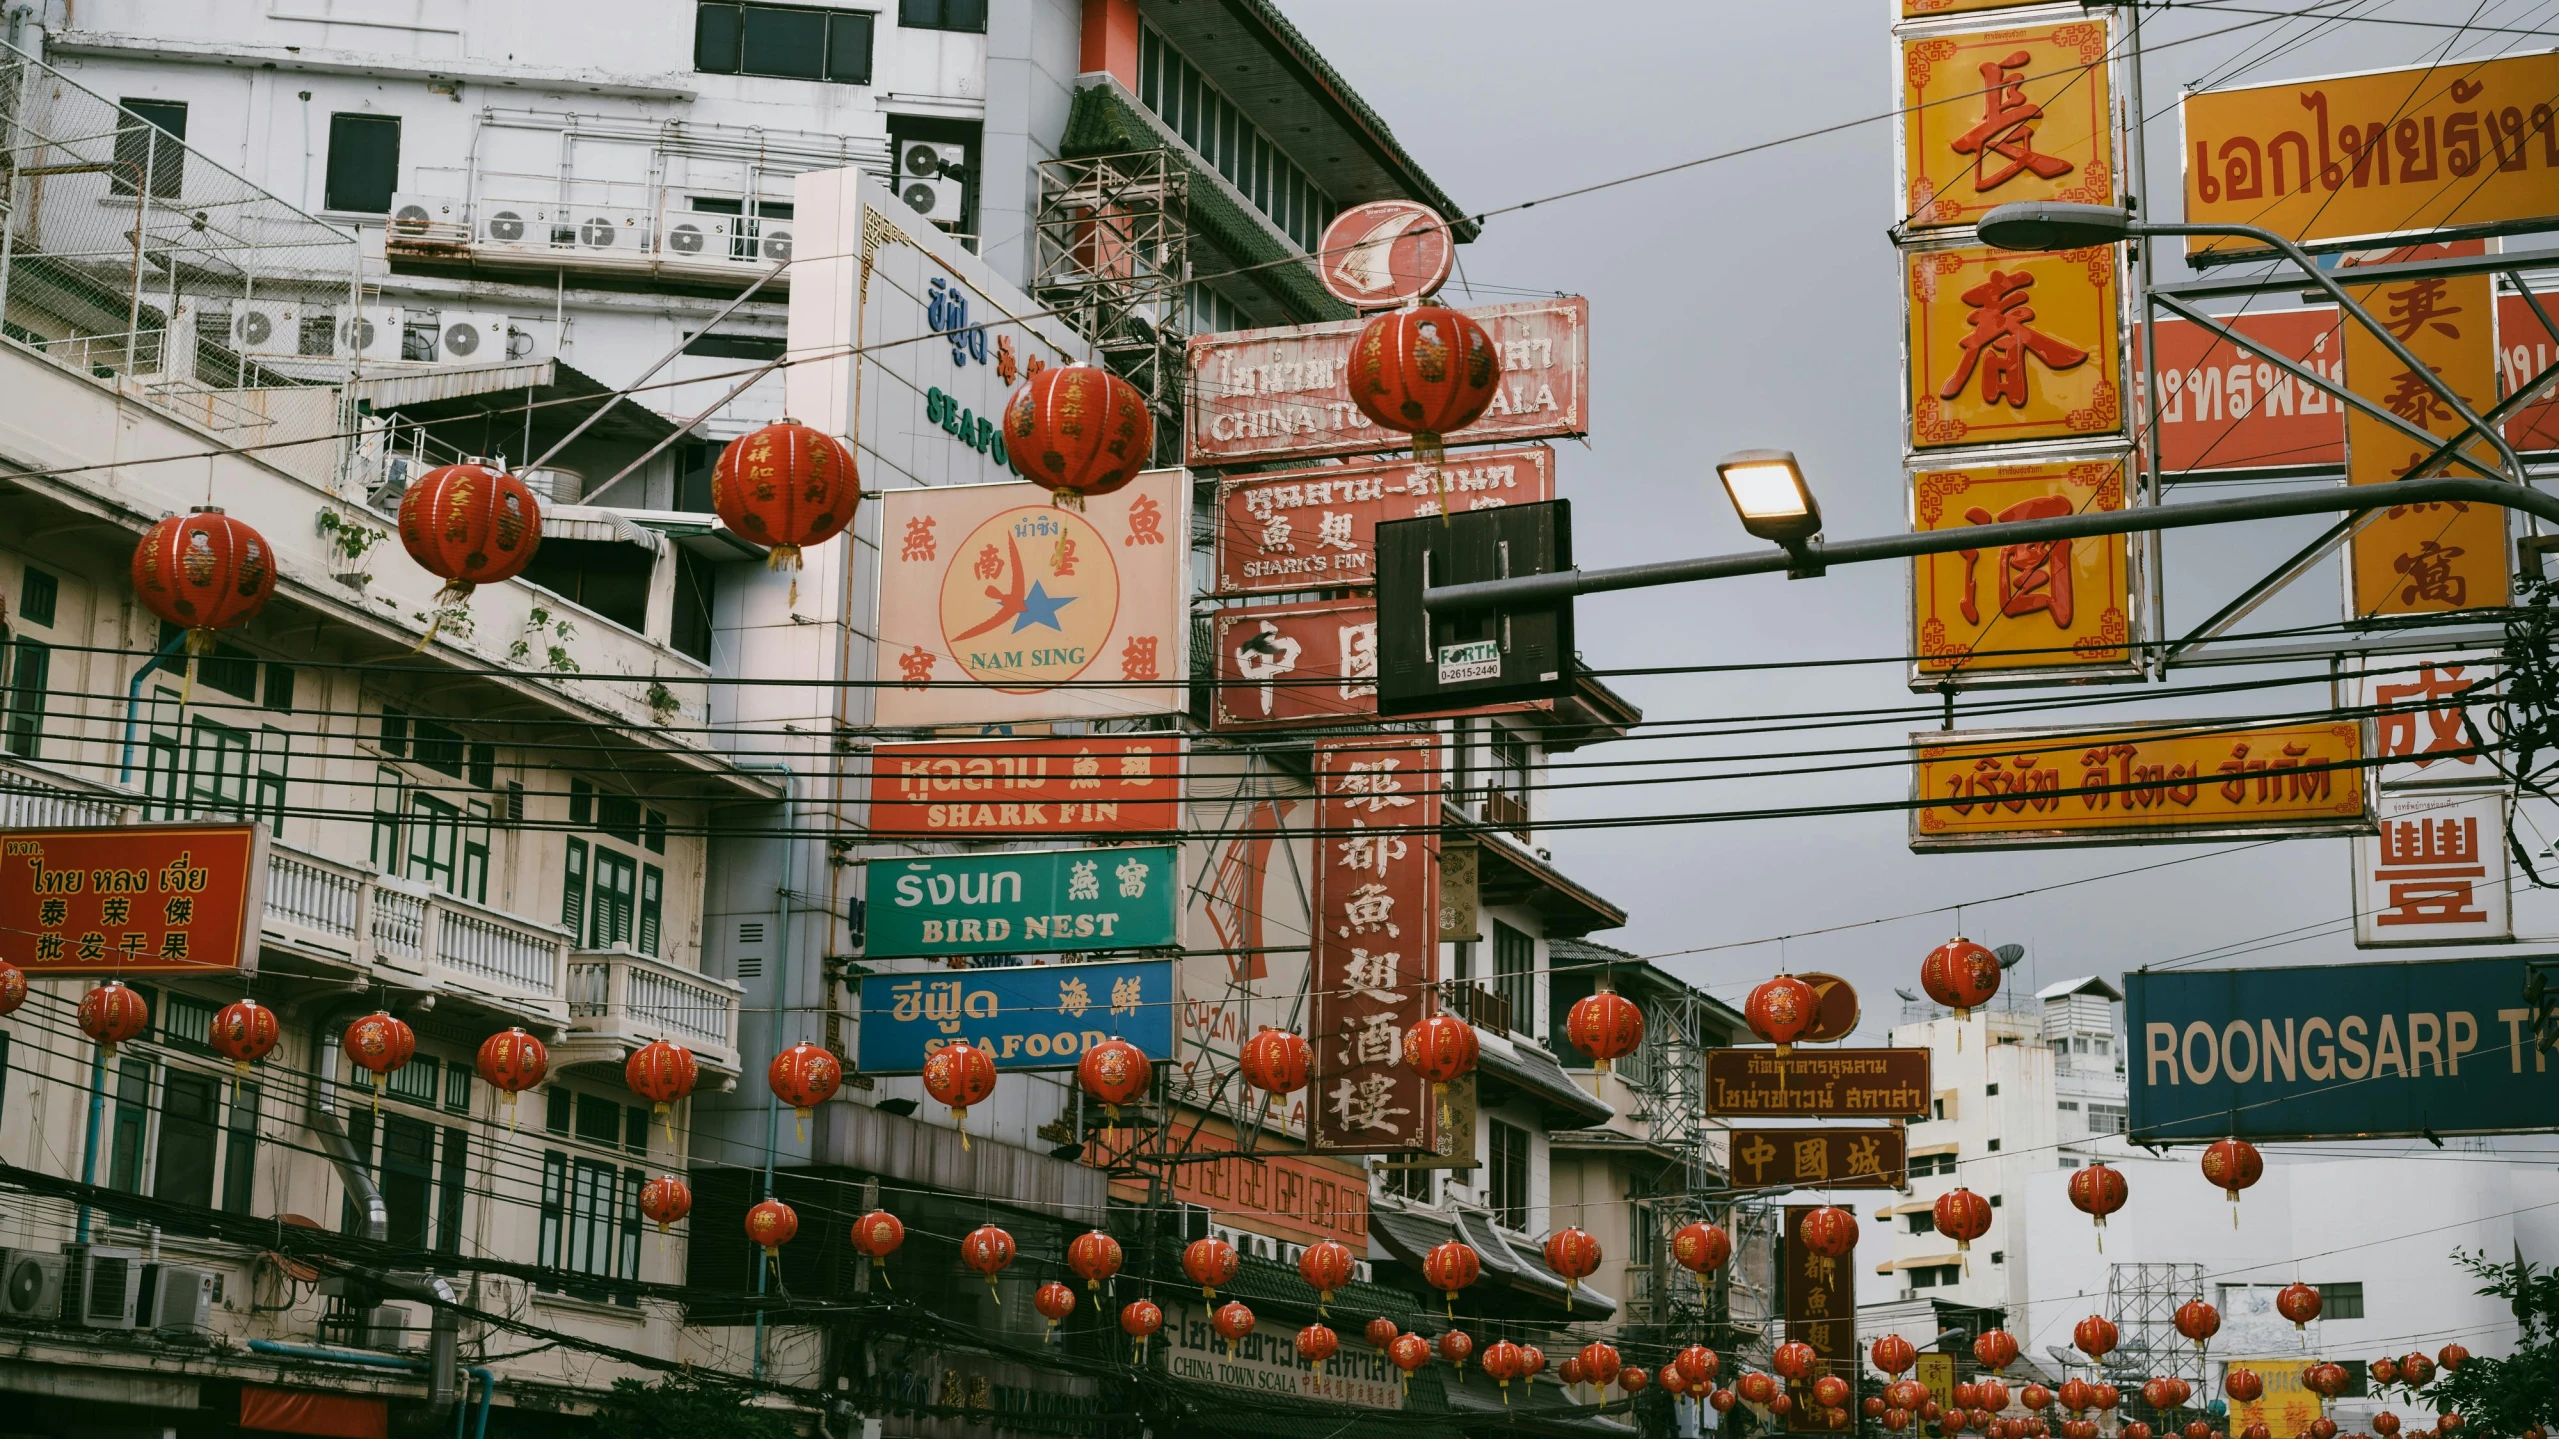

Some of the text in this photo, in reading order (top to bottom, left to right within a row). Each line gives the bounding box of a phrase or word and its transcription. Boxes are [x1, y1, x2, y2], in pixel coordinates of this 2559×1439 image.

[927, 385, 1025, 477] SEAFO
[1210, 384, 1559, 441] CHINA TO ALA
[1255, 510, 1359, 556] 魚翅
[1243, 552, 1367, 579] SHARK'S FIN
[969, 646, 1086, 671] NAM SING
[1440, 664, 1498, 681] 0-2615-2440
[900, 756, 1047, 806] หูฉลาม
[1945, 756, 2060, 817] บริษัท
[2216, 740, 2333, 806] จำกัด
[927, 797, 1120, 829] SHARK FIN
[6, 840, 45, 857] หจก.
[28, 850, 208, 896] ไทย หลง เจี่ย
[894, 856, 1150, 908] รังนก 燕窩
[921, 912, 1120, 944] BIRD NEST
[1058, 974, 1144, 1019] 海鮮
[923, 1030, 1106, 1062] SAFOOD
[2145, 1010, 2479, 1087] ROONGSARP
[1845, 1080, 1922, 1109] สกาล่า
[1741, 1134, 1889, 1183] 中國城
[1173, 1356, 1297, 1395] CHINA TOWN SCALA
